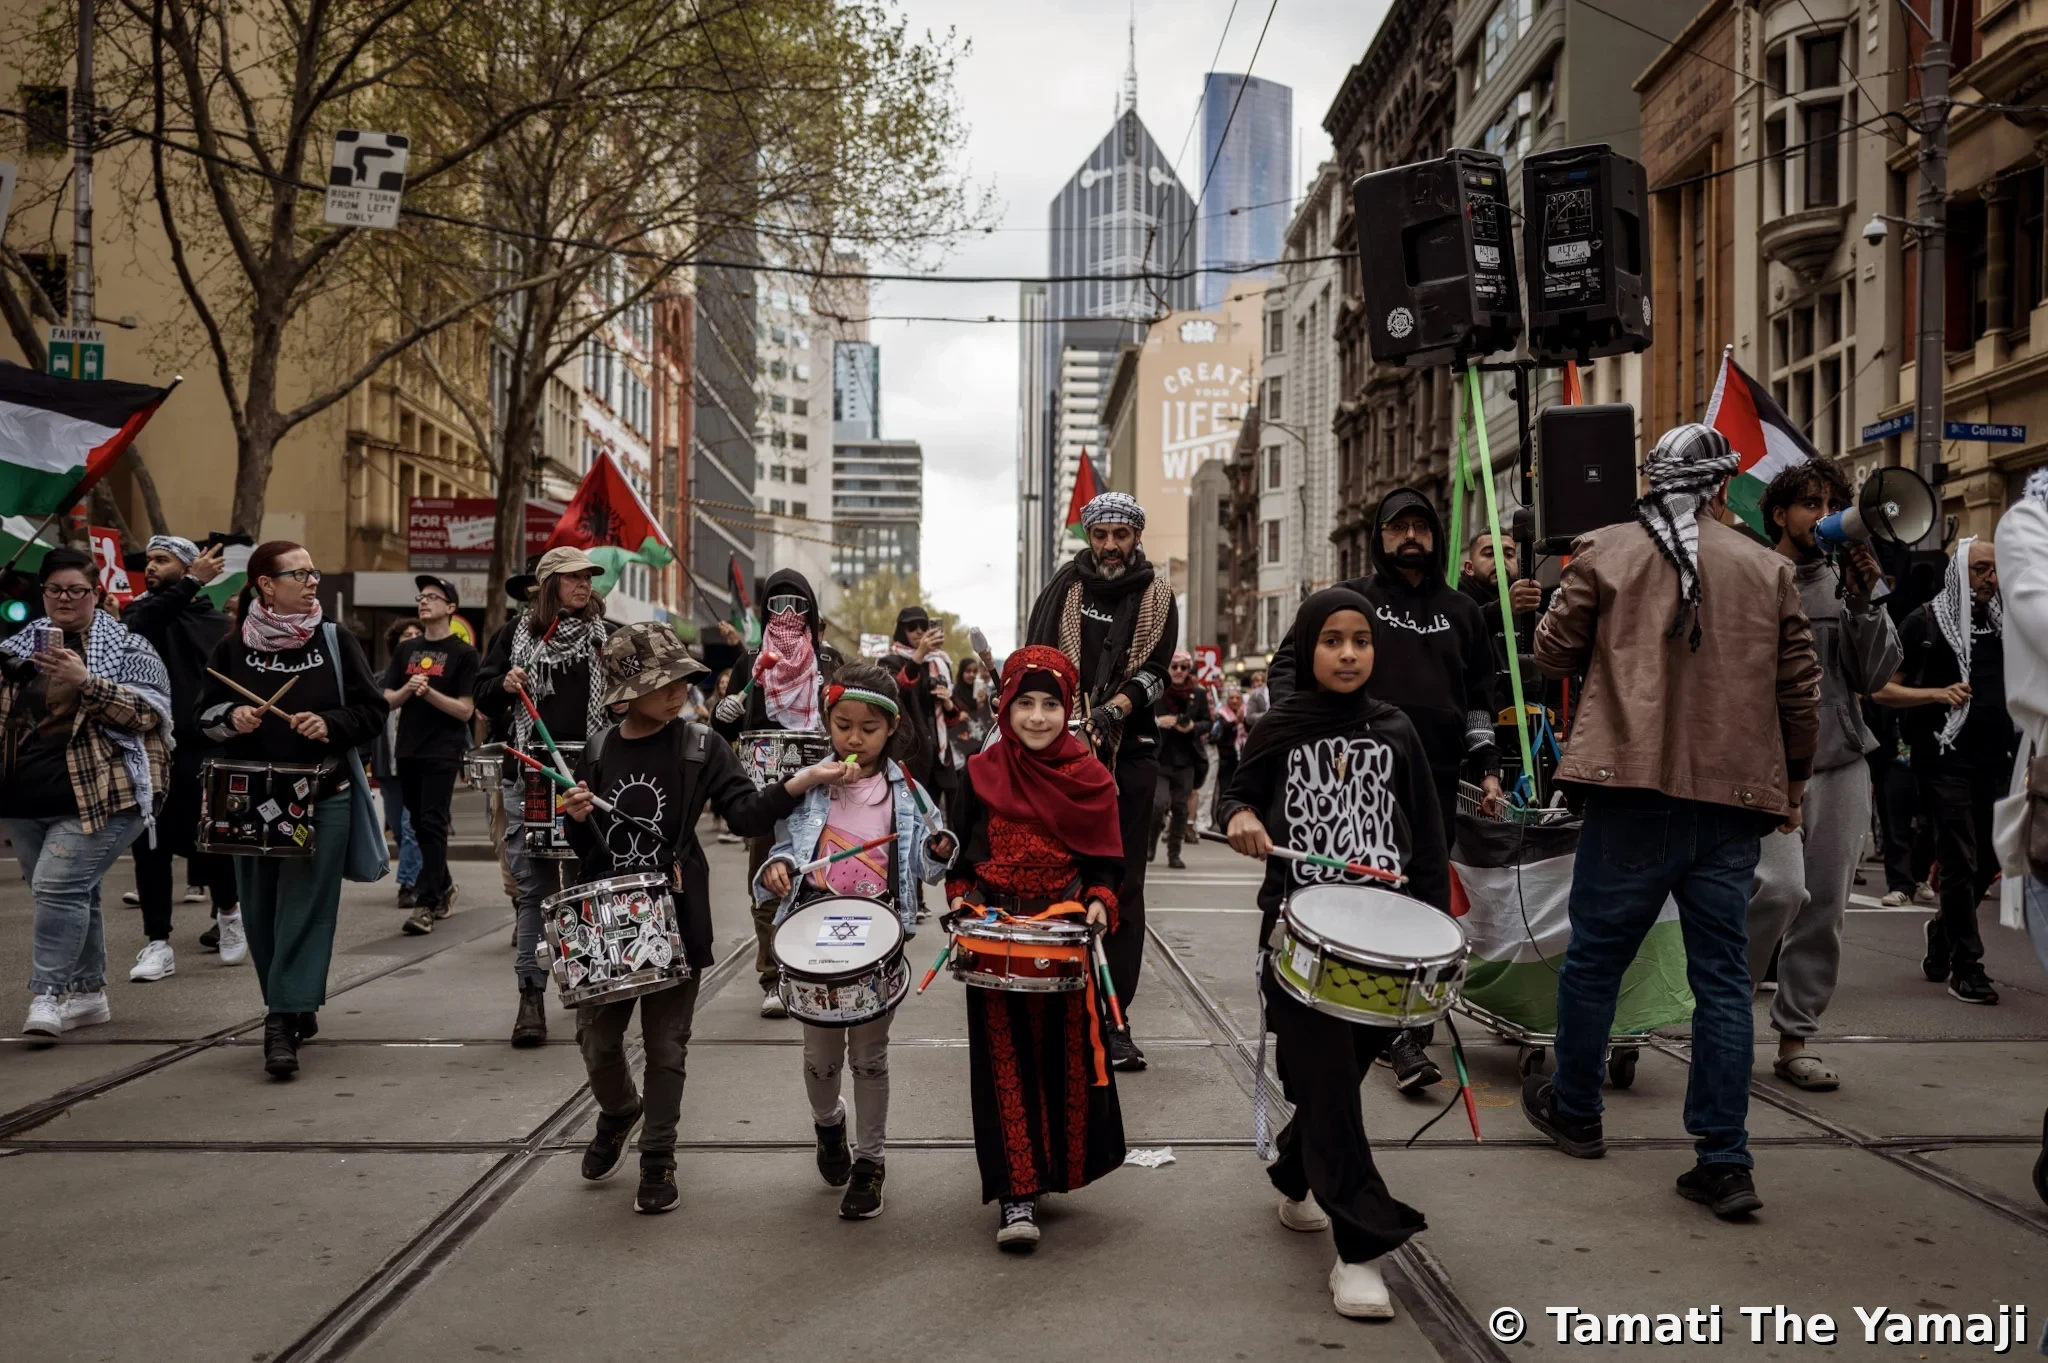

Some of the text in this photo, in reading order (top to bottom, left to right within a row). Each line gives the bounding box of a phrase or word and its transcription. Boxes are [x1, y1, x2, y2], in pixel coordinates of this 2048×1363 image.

[331, 190, 396, 203] RIGHT TURN
[331, 200, 392, 213] FROM LEFT
[346, 212, 374, 222] ONLY
[1557, 244, 1578, 255] ALTO
[51, 328, 101, 341] FAIRWAY
[1163, 362, 1258, 395] CREATE
[1194, 387, 1230, 397] YOUR
[1864, 420, 1892, 438] Elizabeth
[1892, 418, 1901, 429] St
[1971, 425, 2008, 437] Collins
[2011, 426, 2023, 438] St
[410, 514, 441, 528] FOR
[1376, 604, 1451, 634] فلسطين
[245, 648, 324, 673] فلسطين
[1288, 736, 1393, 793] ANTI
[1285, 770, 1396, 824] ZIONIST
[1288, 811, 1400, 860] SOCIAL
